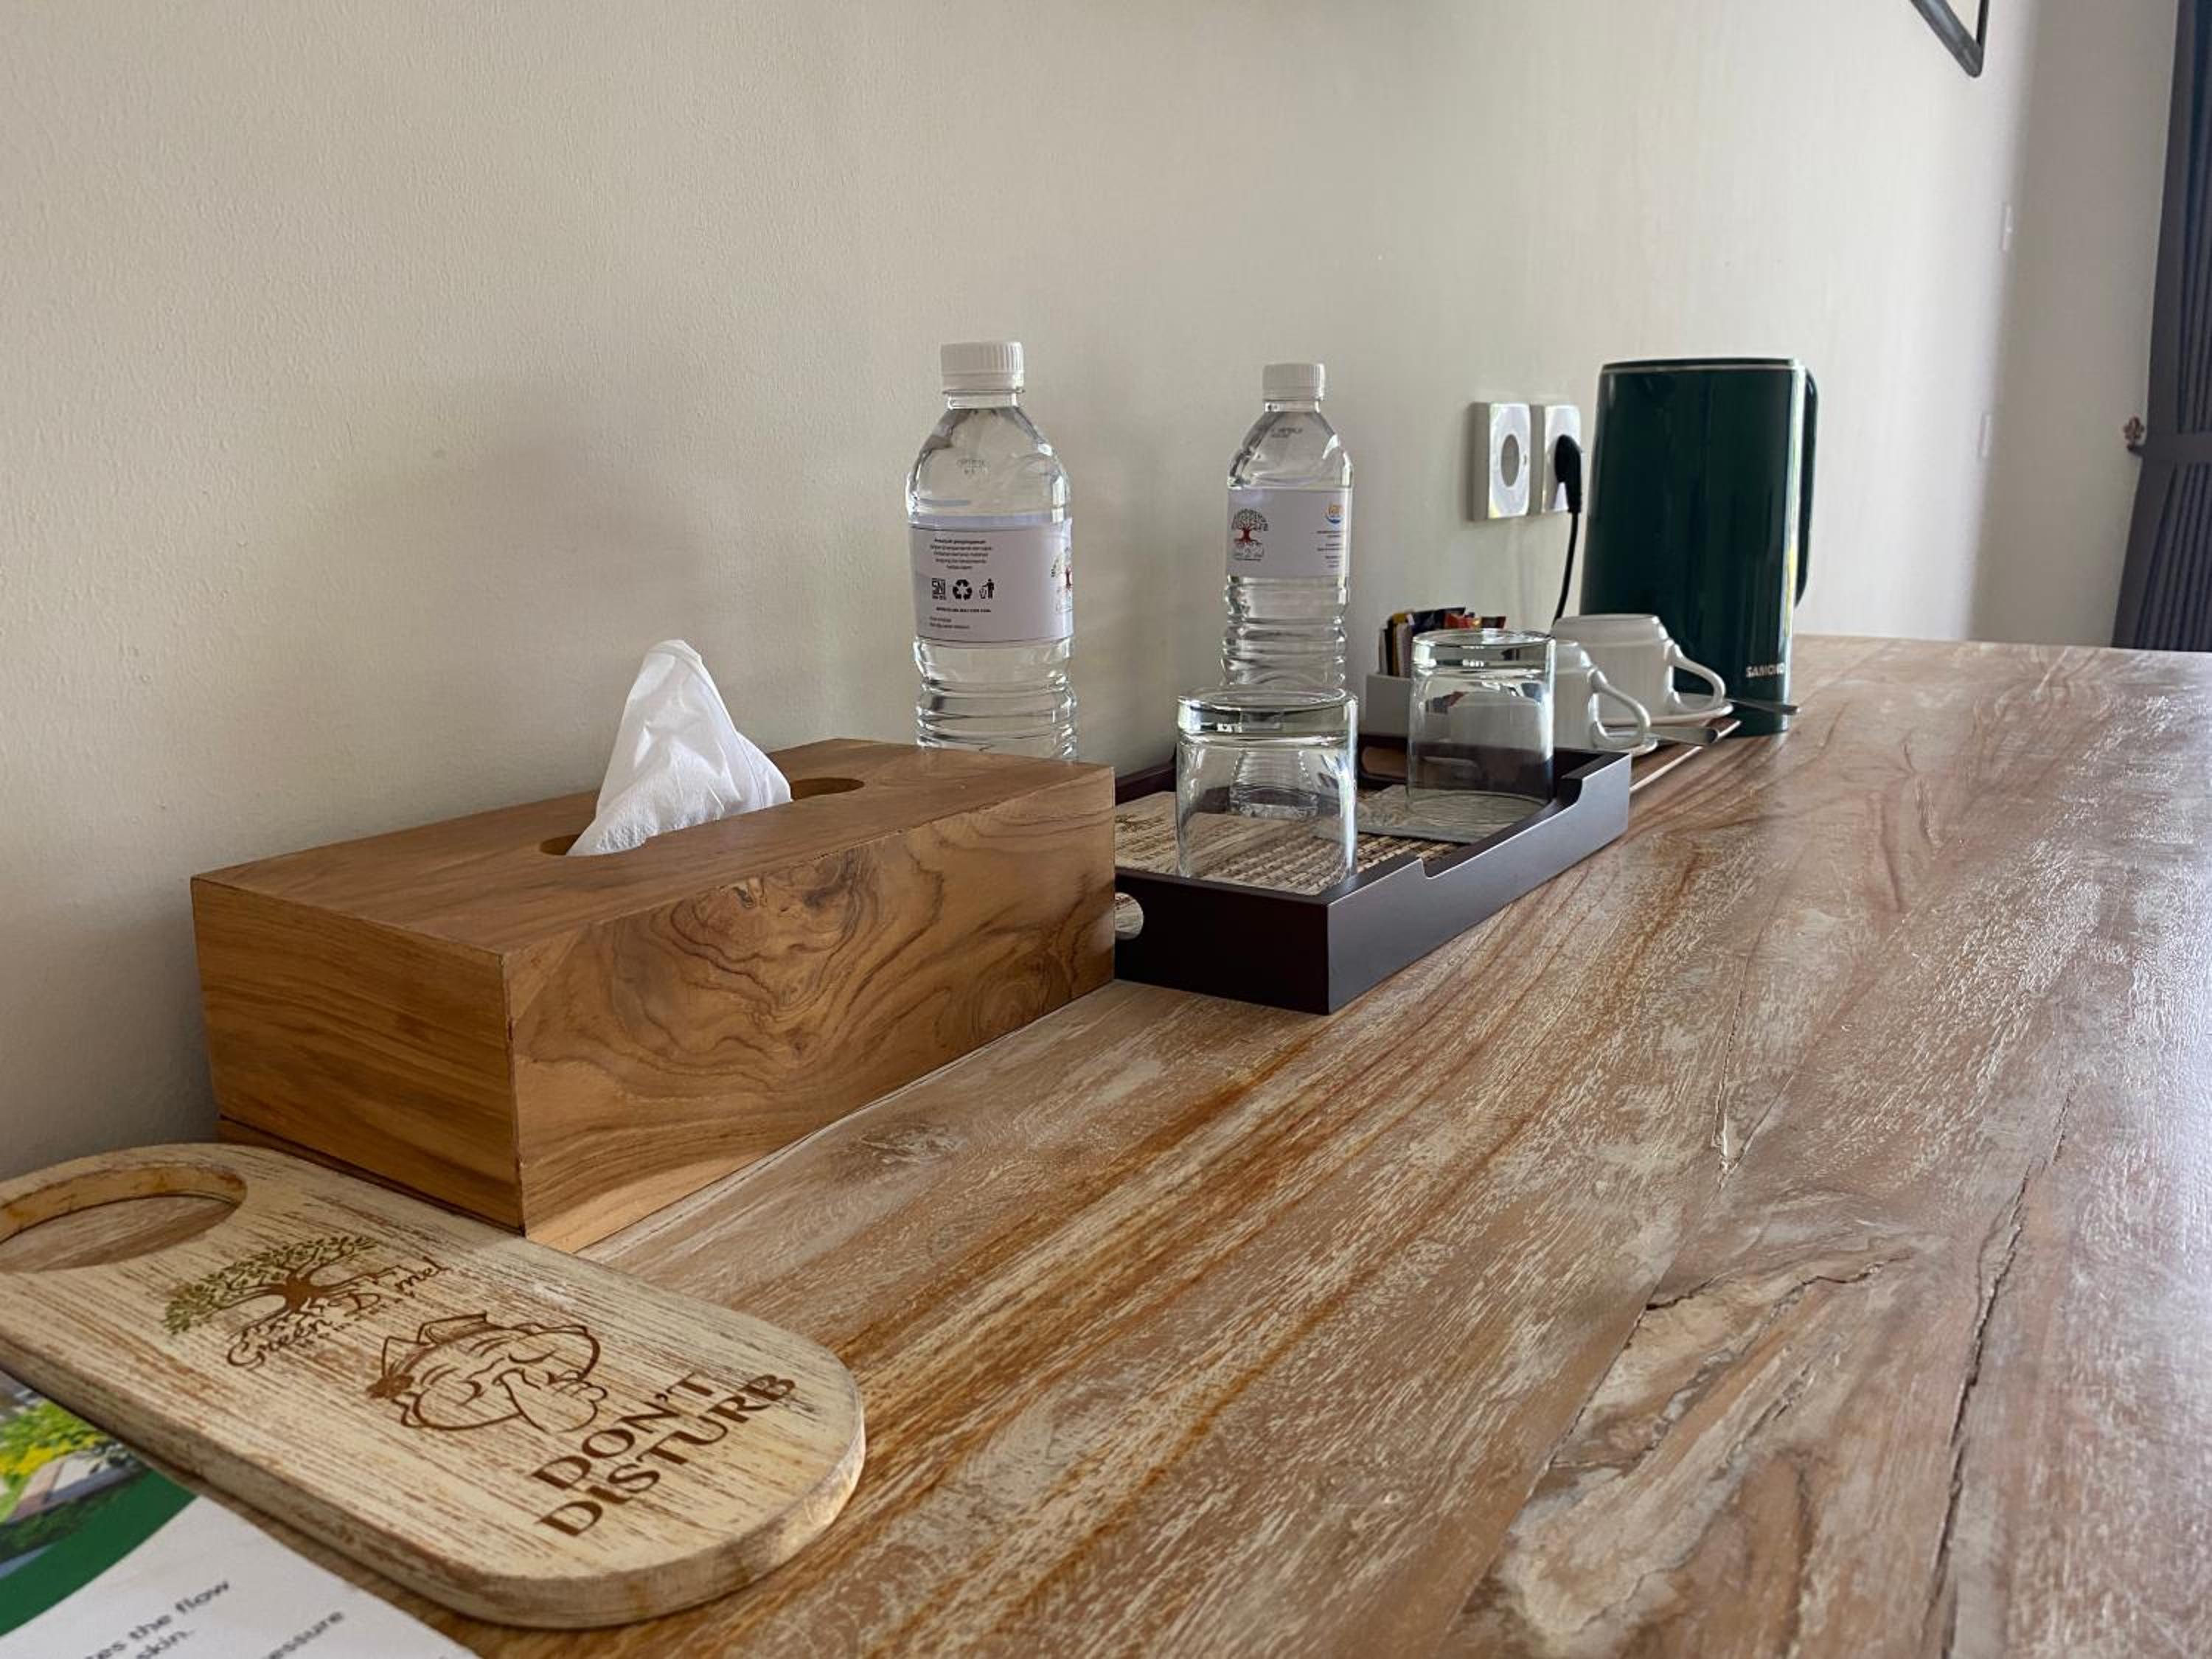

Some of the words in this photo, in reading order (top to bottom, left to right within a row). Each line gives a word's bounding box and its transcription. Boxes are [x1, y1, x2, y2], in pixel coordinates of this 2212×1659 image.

[530, 1371, 714, 1489] DON'T
[537, 1374, 796, 1537] DISTURB
[129, 1615, 172, 1641] the
[175, 1581, 229, 1613] flow
[263, 1612, 344, 1659] essure
